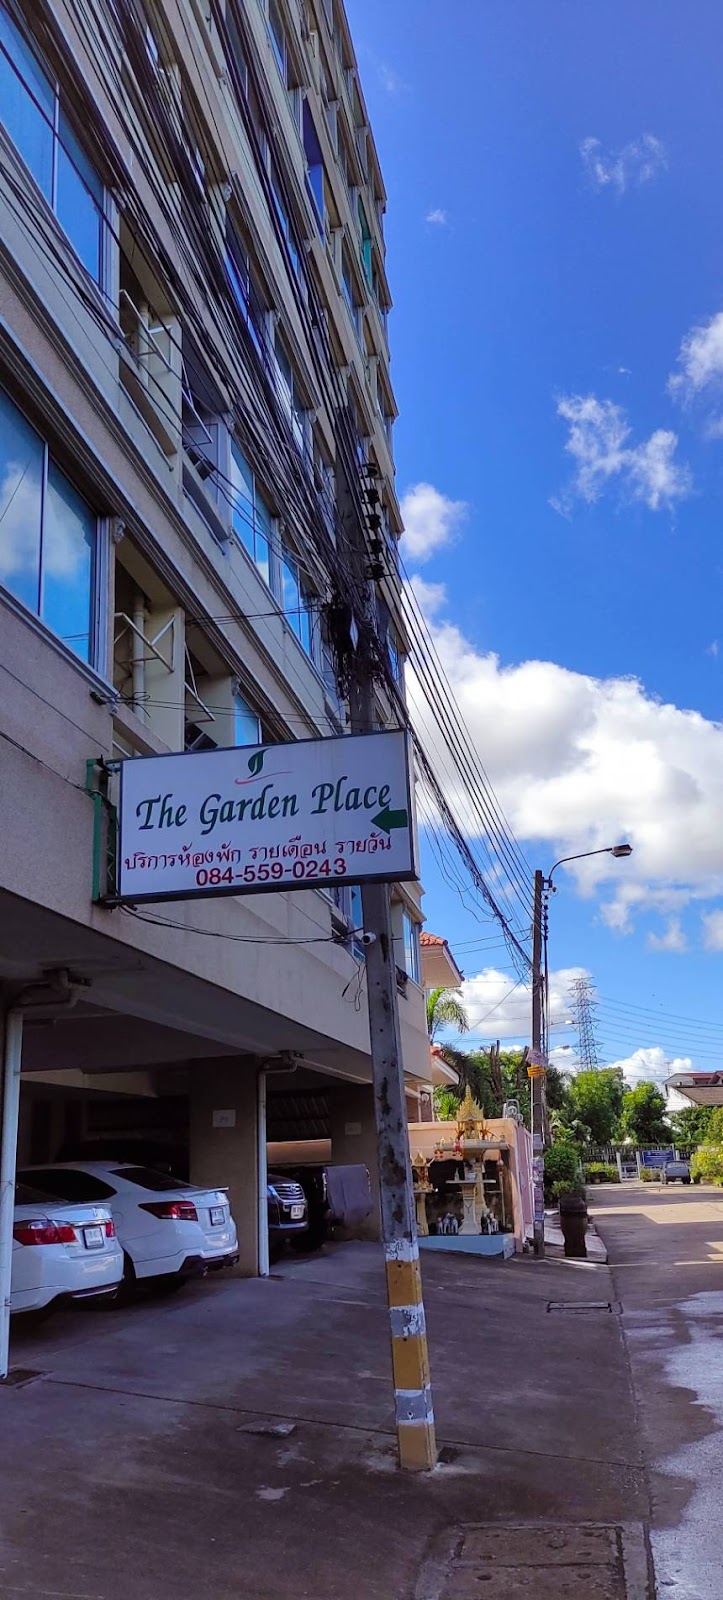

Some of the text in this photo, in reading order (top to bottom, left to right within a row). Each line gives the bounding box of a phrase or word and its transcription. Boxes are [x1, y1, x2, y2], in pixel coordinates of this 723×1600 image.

[136, 776, 392, 835] The Garden Place
[125, 831, 393, 871] บริการห้องพัก รายเดือน รายวัน
[195, 857, 347, 886] 084-559-0243
